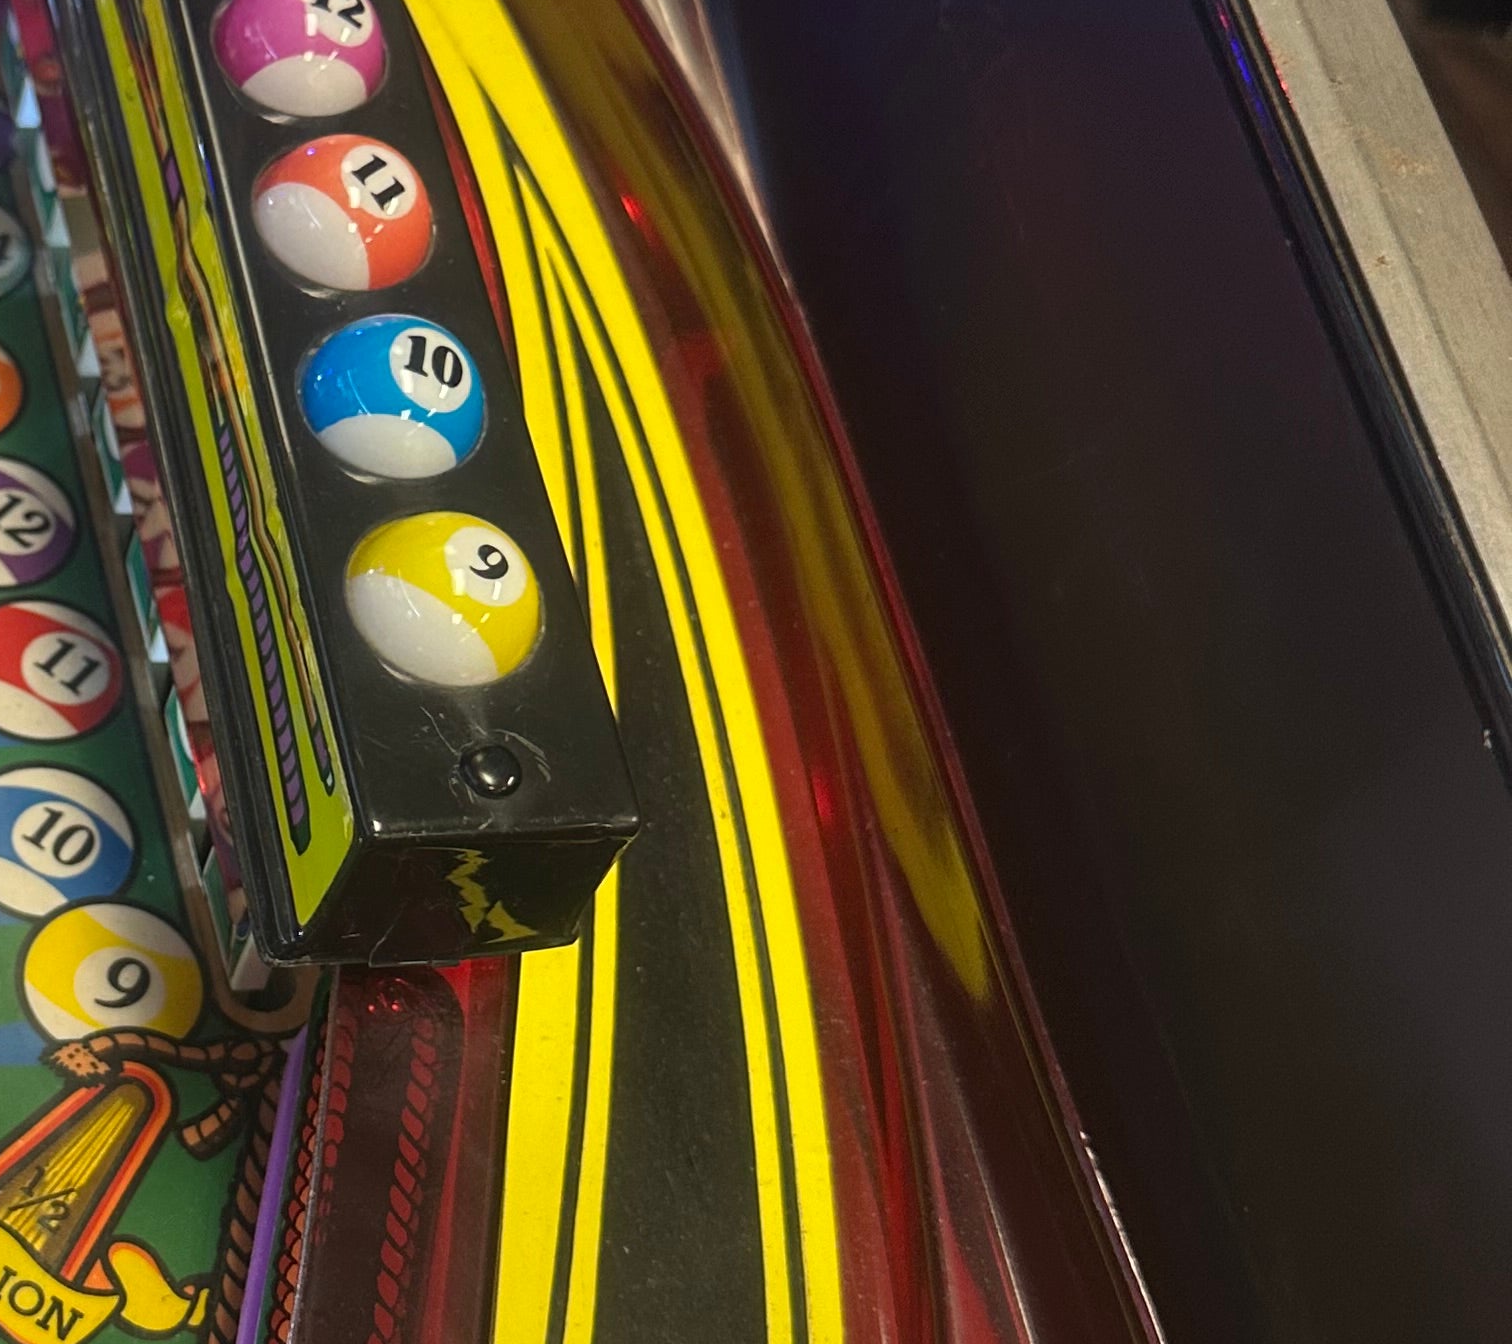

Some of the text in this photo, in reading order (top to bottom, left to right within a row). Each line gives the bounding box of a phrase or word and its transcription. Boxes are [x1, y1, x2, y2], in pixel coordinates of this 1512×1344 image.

[351, 154, 406, 210] 11
[402, 336, 464, 390] 10
[469, 544, 510, 581] 9
[35, 638, 100, 697] 11
[22, 807, 96, 866] 10
[94, 957, 151, 1008] 9
